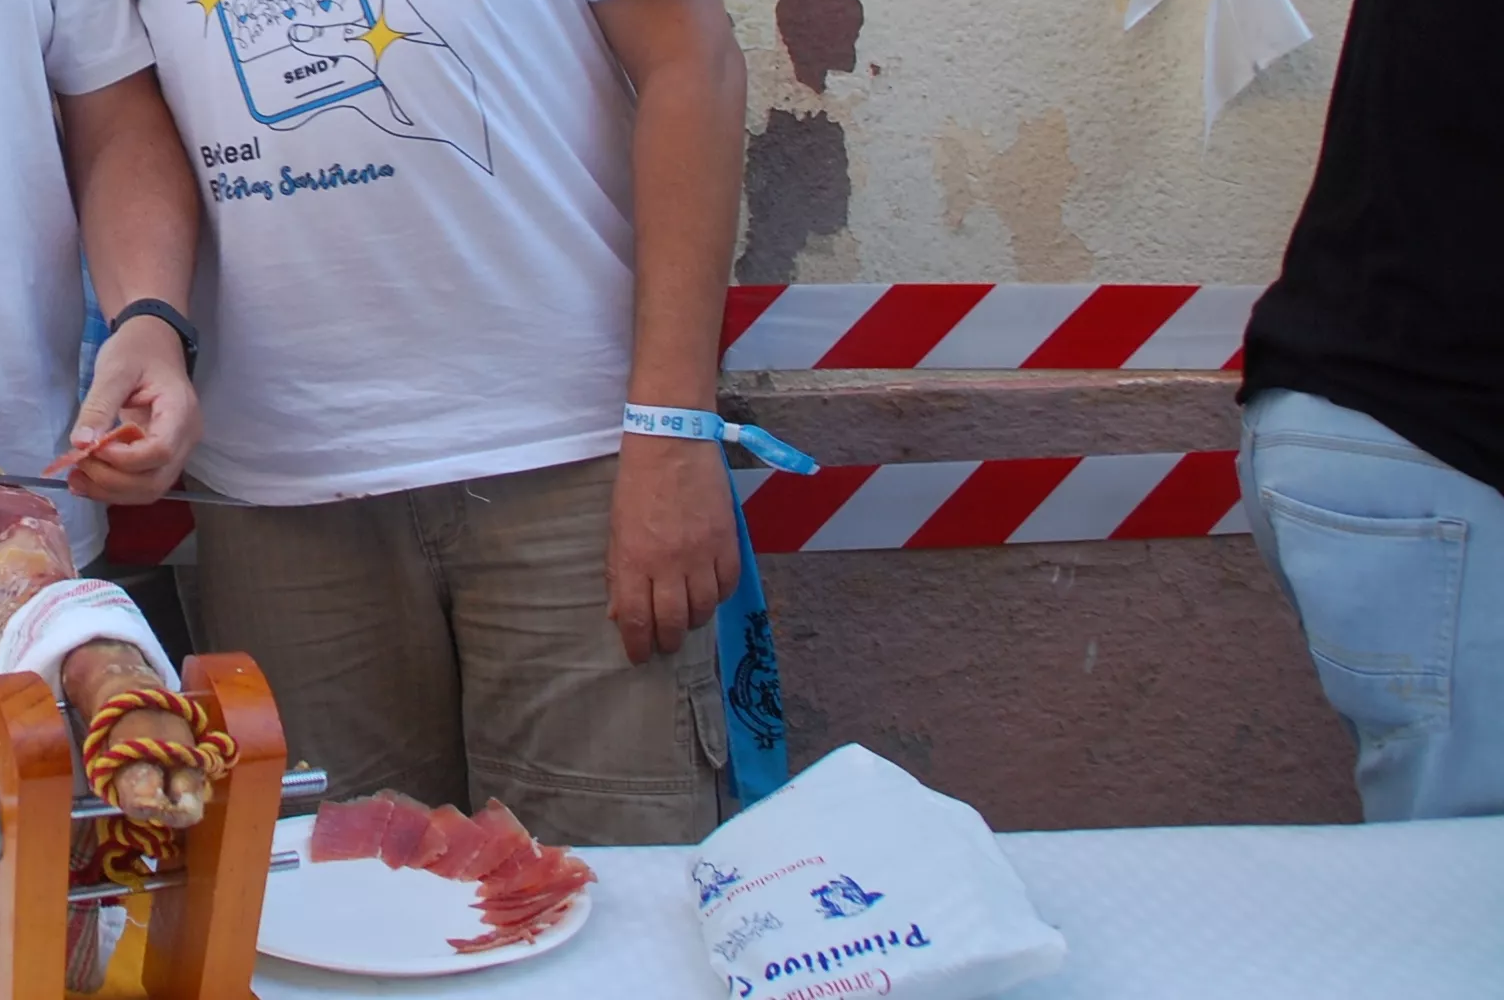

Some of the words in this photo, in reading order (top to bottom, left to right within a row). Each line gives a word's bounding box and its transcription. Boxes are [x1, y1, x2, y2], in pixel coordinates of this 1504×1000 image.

[284, 59, 329, 85] SEND
[279, 163, 396, 197] Sariñena
[764, 922, 932, 982] Primitivo
